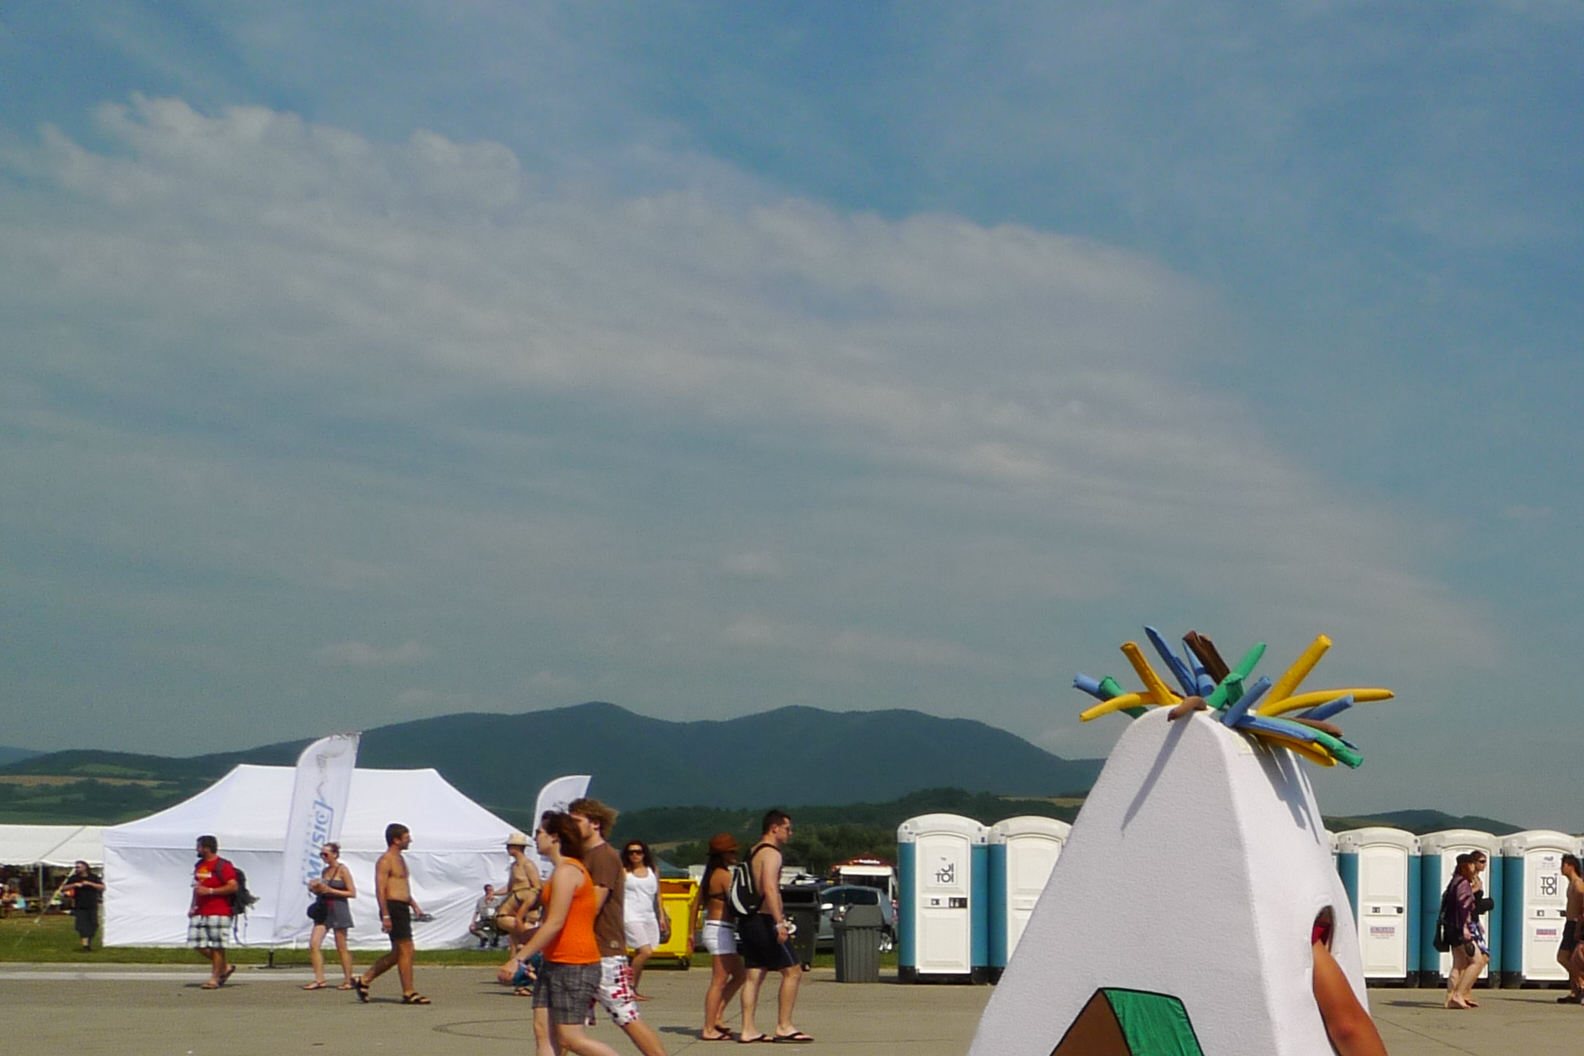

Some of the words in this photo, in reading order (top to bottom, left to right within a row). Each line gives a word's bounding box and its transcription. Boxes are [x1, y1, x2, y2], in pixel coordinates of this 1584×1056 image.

[306, 810, 330, 880] MUSIC
[935, 872, 955, 883] TOI
[1540, 885, 1558, 895] TOI
